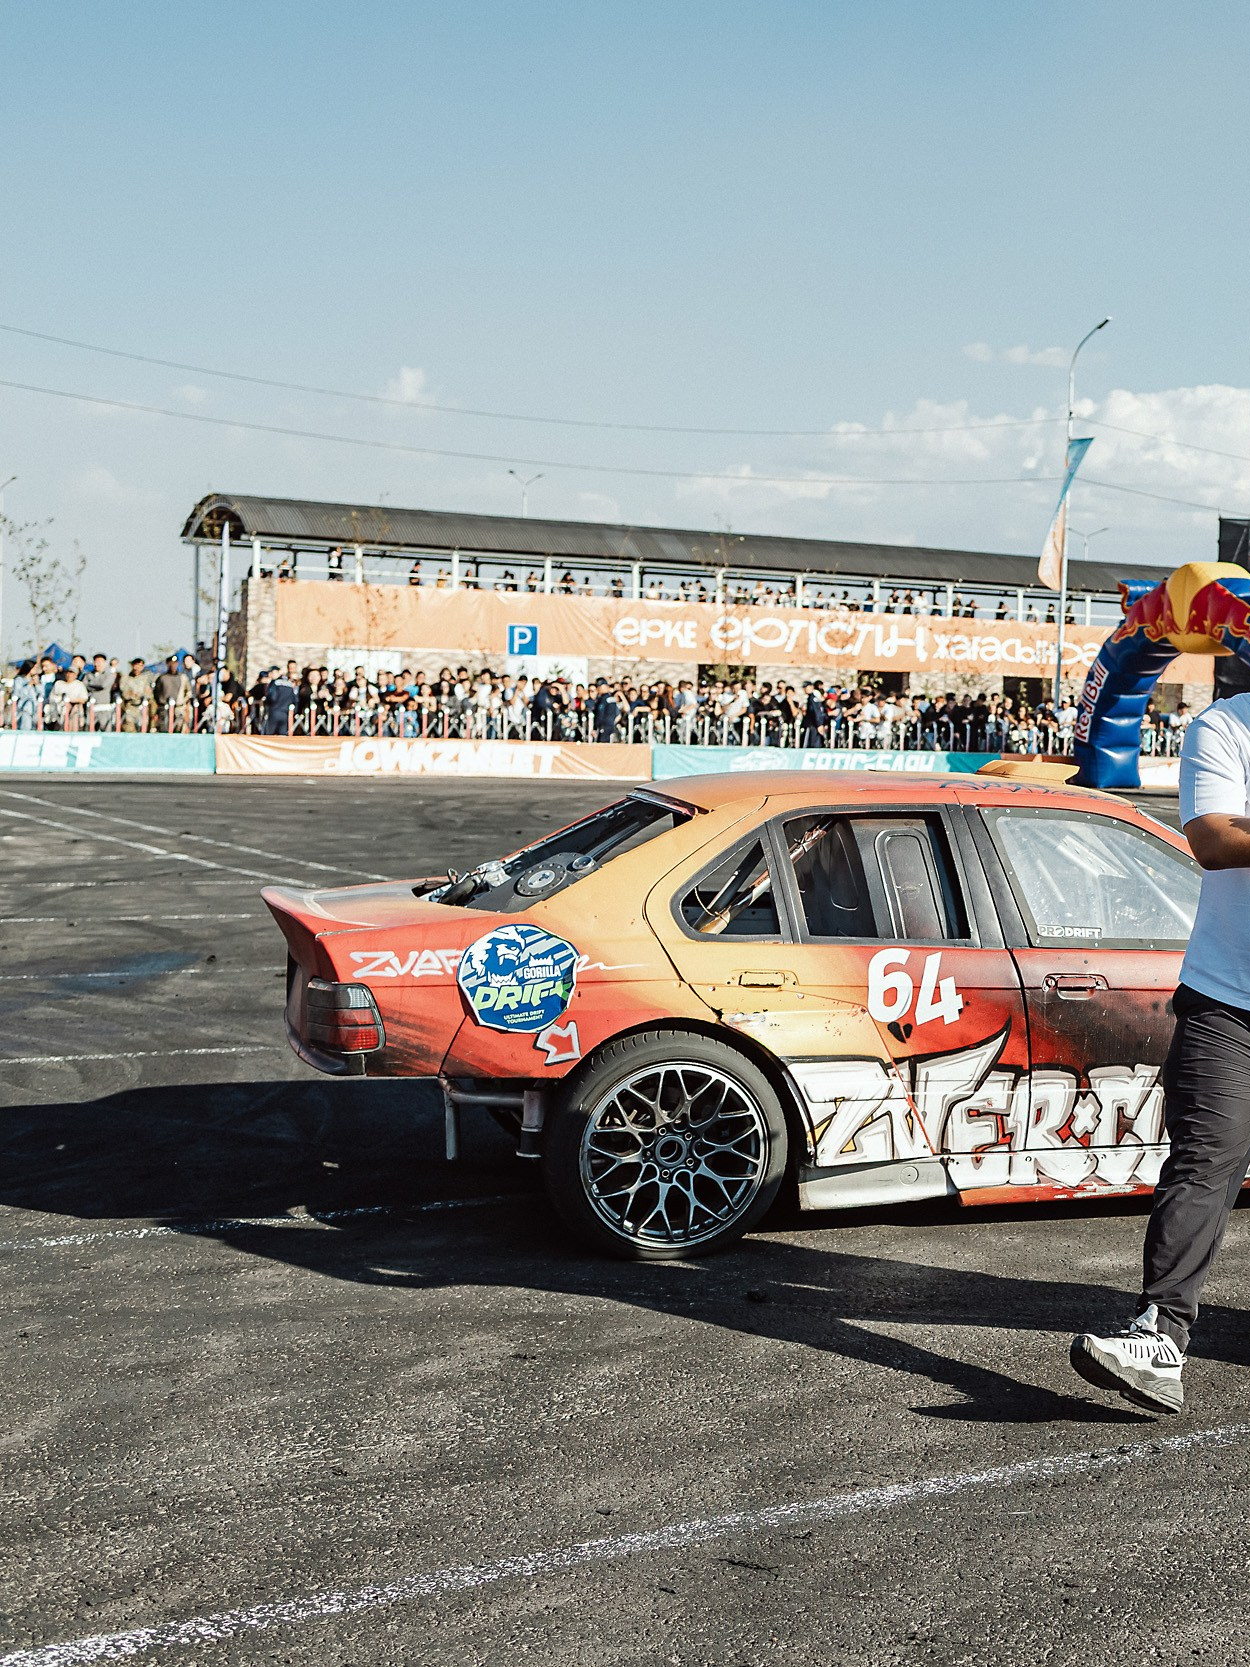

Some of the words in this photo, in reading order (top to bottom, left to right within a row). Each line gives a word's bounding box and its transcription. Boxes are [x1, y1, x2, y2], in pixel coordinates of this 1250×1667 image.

[514, 627, 532, 653] P
[1075, 699, 1093, 741] Red
[1085, 661, 1106, 701] Bull
[523, 965, 561, 979] GORILLA
[867, 948, 963, 1026] 64
[503, 1011, 529, 1021] ULTIMATE
[529, 1009, 545, 1018] DRIFT
[507, 1014, 543, 1025] TOURNAMENT
